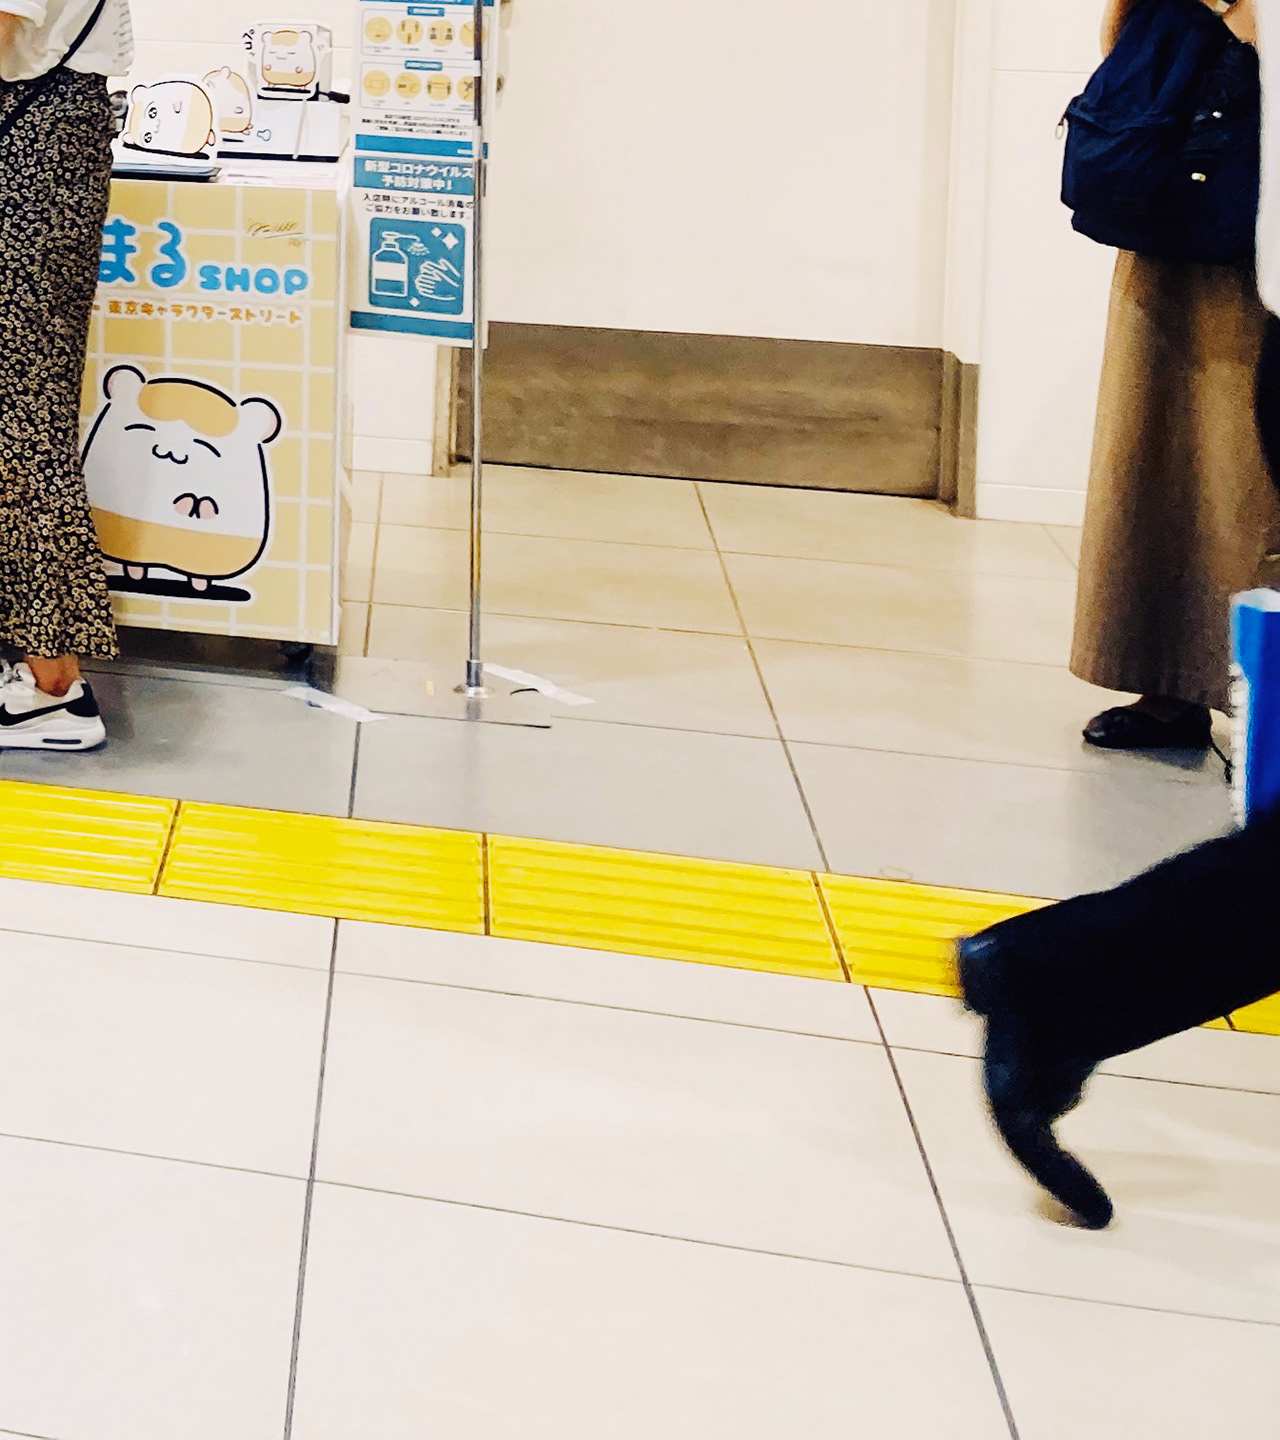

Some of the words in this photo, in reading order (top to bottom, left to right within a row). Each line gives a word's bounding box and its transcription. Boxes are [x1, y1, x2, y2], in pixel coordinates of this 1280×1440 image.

[365, 160, 474, 178] 新型コロナウイルス
[199, 264, 308, 295] SHOP
[107, 299, 302, 325] 東京キャラクターストリート
